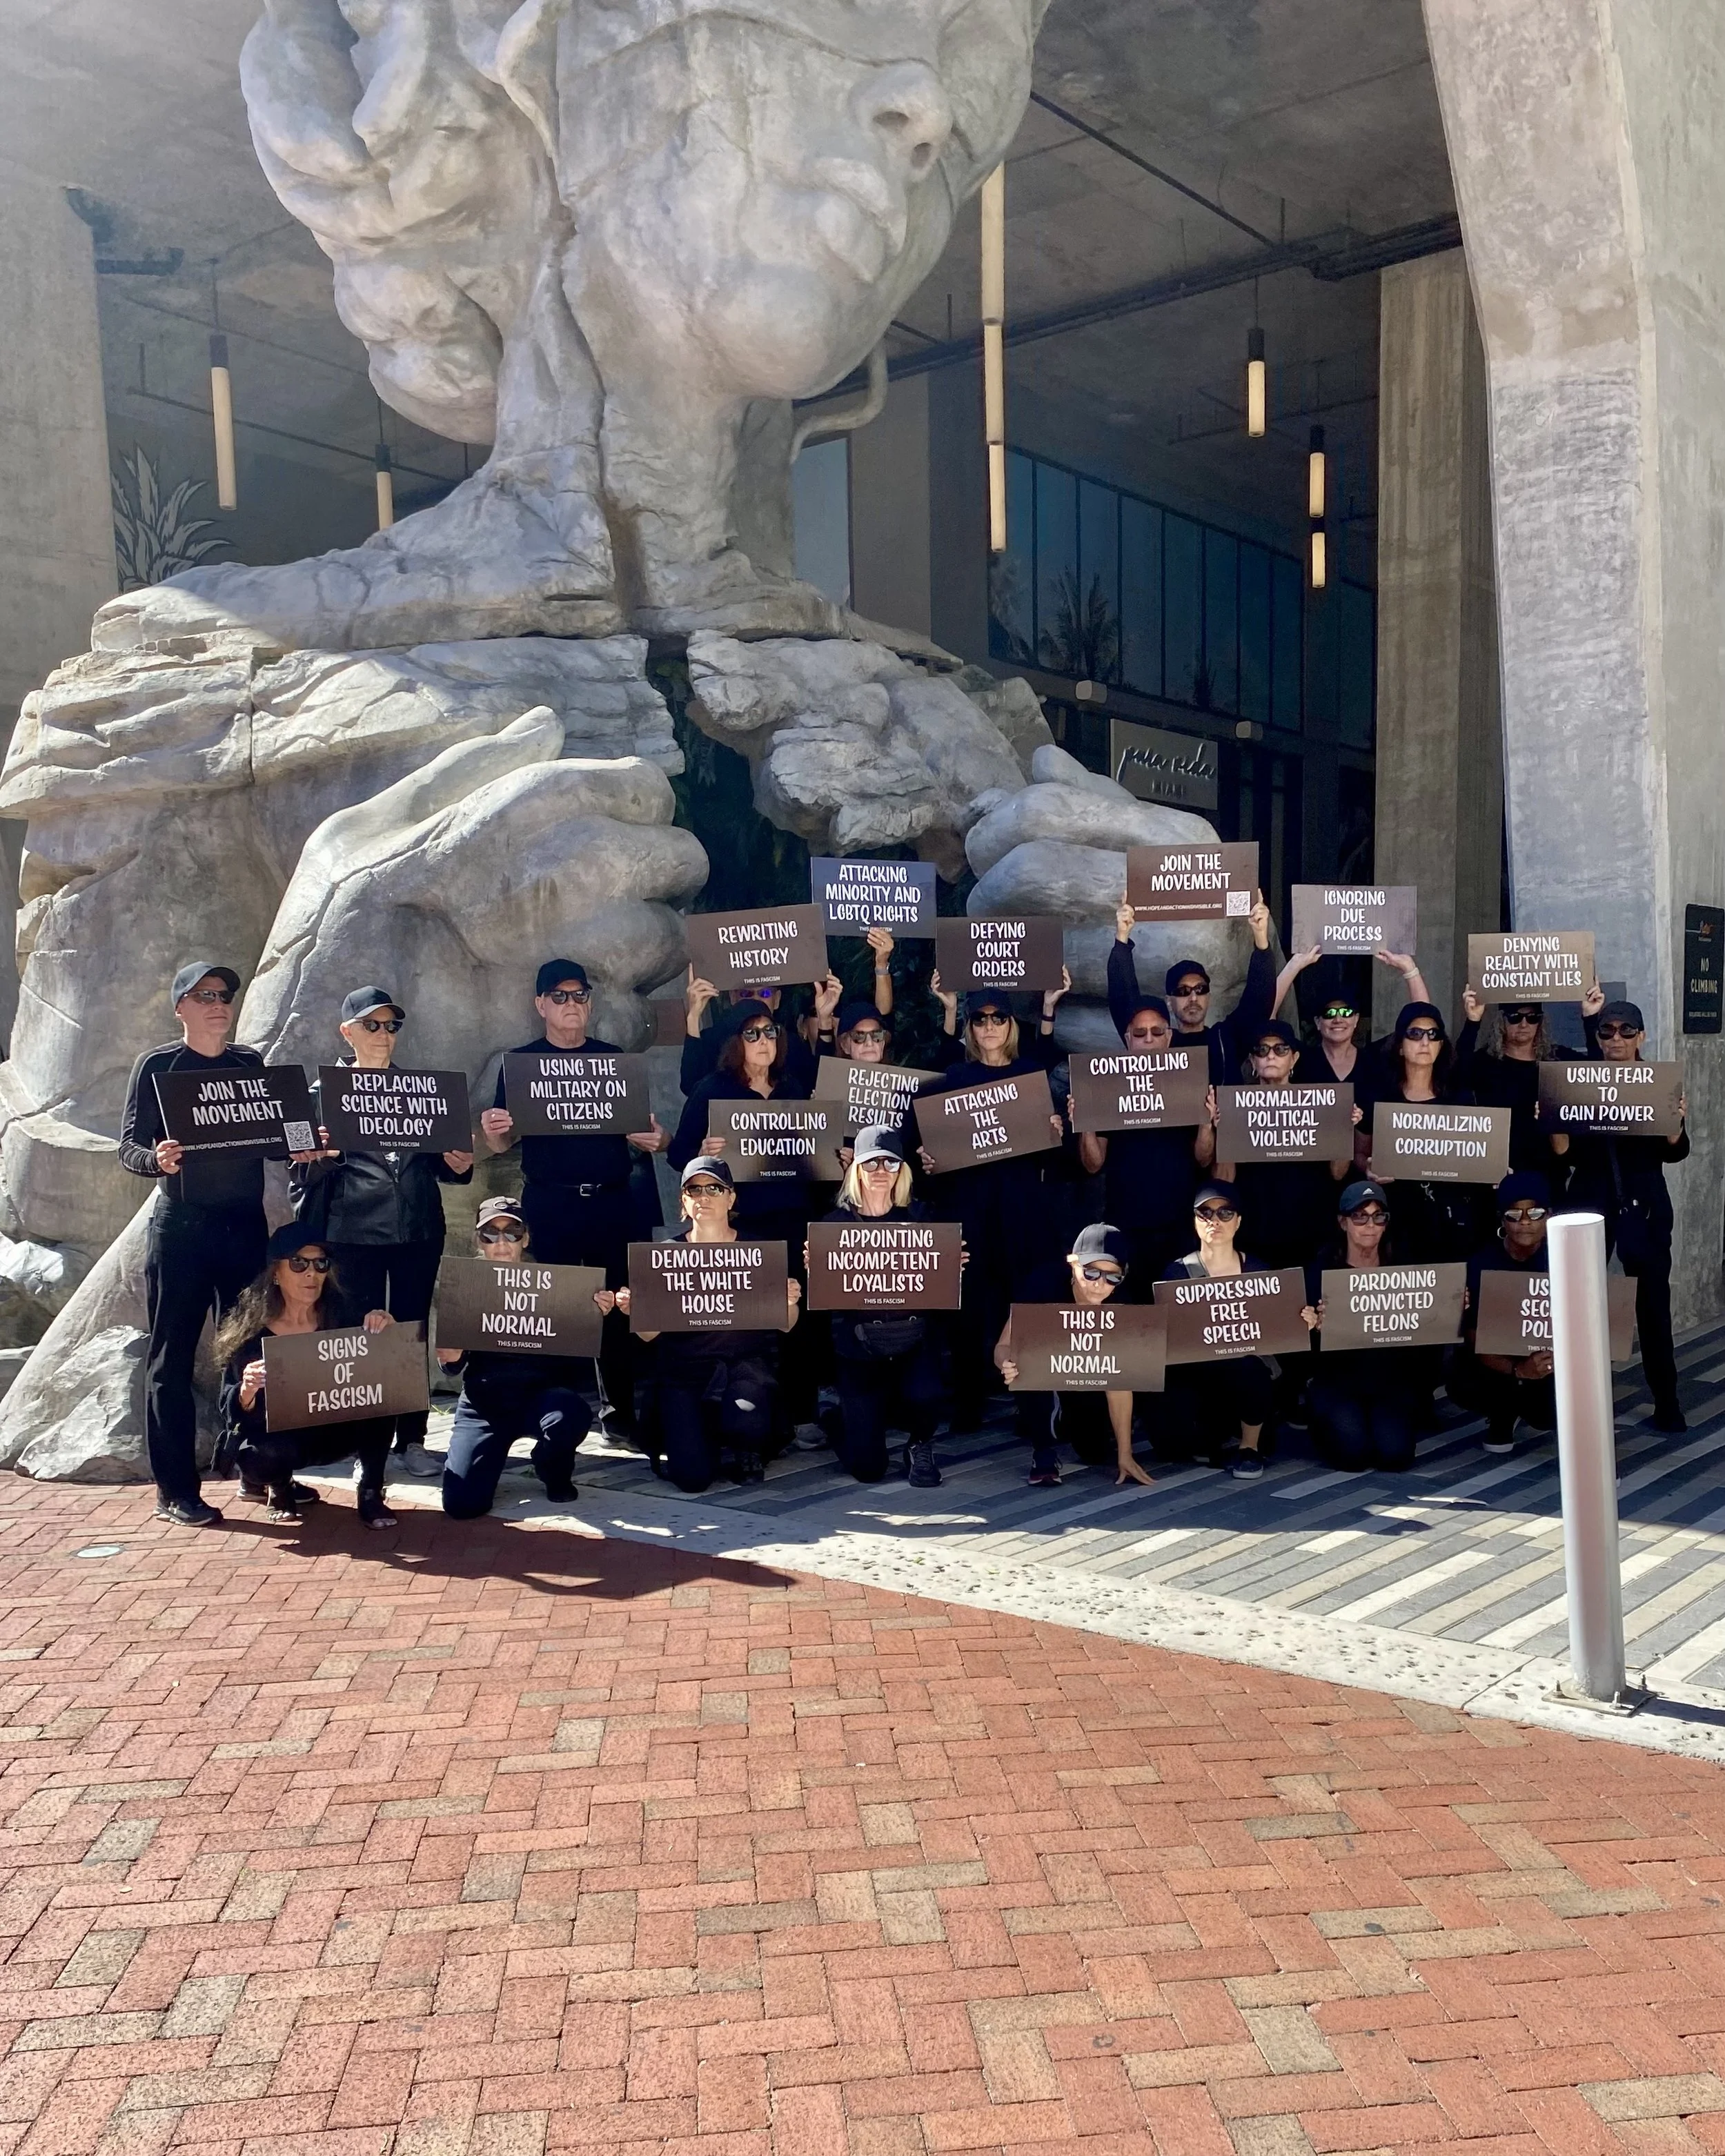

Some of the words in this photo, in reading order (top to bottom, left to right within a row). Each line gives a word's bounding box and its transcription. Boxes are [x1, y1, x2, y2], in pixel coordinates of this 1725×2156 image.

[1159, 855, 1192, 872] JOIN
[1195, 853, 1222, 870] THE
[839, 864, 908, 883] ATTACKING
[1151, 873, 1231, 891] MOVEMENT
[825, 884, 891, 901] MINORITY
[894, 886, 921, 904] AND
[1324, 890, 1386, 906] IGNORING
[829, 904, 871, 924] LGBTQ
[873, 904, 918, 922] RIGHTS
[1341, 909, 1366, 923] DUE
[718, 920, 798, 944] REWRITING
[971, 922, 1026, 940] DEFYING
[1324, 925, 1382, 941] PROCESS
[976, 941, 1020, 958] COURT
[1504, 936, 1559, 953] DENYING
[729, 947, 789, 969] HISTORY
[1485, 955, 1543, 971] REALITY
[1544, 953, 1578, 969] WITH
[1701, 958, 1709, 972] NO
[972, 960, 1025, 977] ORDERS
[1482, 971, 1552, 989] CONSTANT
[1555, 970, 1581, 987] LIES
[1690, 980, 1717, 993] CLIMBING
[540, 1058, 584, 1076] USING
[587, 1058, 618, 1076] THE
[1090, 1052, 1189, 1075] CONTROLLING
[352, 1074, 437, 1094] REPLACING
[848, 1067, 920, 1093] REJECTING
[1126, 1074, 1154, 1092] THE
[1567, 1067, 1611, 1083] USING
[1615, 1067, 1655, 1084] FEAR
[198, 1082, 236, 1102] JOIN
[236, 1078, 270, 1099] THE
[530, 1080, 601, 1098] MILITARY
[605, 1080, 627, 1098] ON
[1235, 1089, 1336, 1108] NORMALIZING
[1598, 1087, 1618, 1102] TO
[342, 1095, 402, 1114] SCIENCE
[406, 1096, 448, 1115] WITH
[848, 1088, 911, 1111] ELECTION
[944, 1083, 1018, 1116] ATTACKING
[1118, 1094, 1165, 1113] MEDIA
[192, 1100, 284, 1126] MOVEMENT
[546, 1102, 613, 1120] CITIZENS
[848, 1105, 903, 1127] RESULTS
[970, 1108, 1000, 1128] THE
[1248, 1109, 1319, 1127] POLITICAL
[1559, 1105, 1595, 1121] GAIN
[1599, 1105, 1655, 1122] POWER
[359, 1116, 433, 1136] IDEOLOGY
[731, 1112, 827, 1131] CONTROLLING
[1392, 1113, 1492, 1133] NORMALIZING
[740, 1138, 816, 1156] EDUCATION
[972, 1127, 1008, 1150] ARTS
[1250, 1129, 1317, 1147] VIOLENCE
[993, 1147, 1012, 1156] FASCISM
[1395, 1138, 1487, 1158] CORRUPTION
[839, 1229, 934, 1248] APPOINTING
[651, 1248, 762, 1269] DEMOLISHING
[828, 1252, 940, 1271] INCOMPETENT
[493, 1267, 531, 1289] THIS
[537, 1270, 551, 1290] IS
[662, 1272, 695, 1292] THE
[699, 1271, 752, 1291] WHITE
[843, 1274, 924, 1292] LOYALISTS
[1349, 1270, 1437, 1292] PARDONING
[1529, 1278, 1550, 1296] US
[1175, 1276, 1281, 1305] SUPPRESSING
[504, 1292, 538, 1312] NOT
[682, 1294, 735, 1314] HOUSE
[1350, 1292, 1434, 1313] CONVICTED
[1520, 1299, 1552, 1318] SEC
[1059, 1311, 1095, 1329] THIS
[1100, 1311, 1115, 1329] IS
[1210, 1301, 1249, 1323] FREE
[482, 1313, 556, 1337] NORMAL
[1363, 1313, 1419, 1333] FELONS
[1522, 1319, 1553, 1339] POL
[1070, 1334, 1103, 1352] NOT
[1203, 1322, 1261, 1345] SPEECH
[318, 1335, 368, 1362] SIGNS
[333, 1362, 355, 1385] OF
[1050, 1355, 1121, 1374] NORMAL
[308, 1383, 383, 1414] FASCISM
